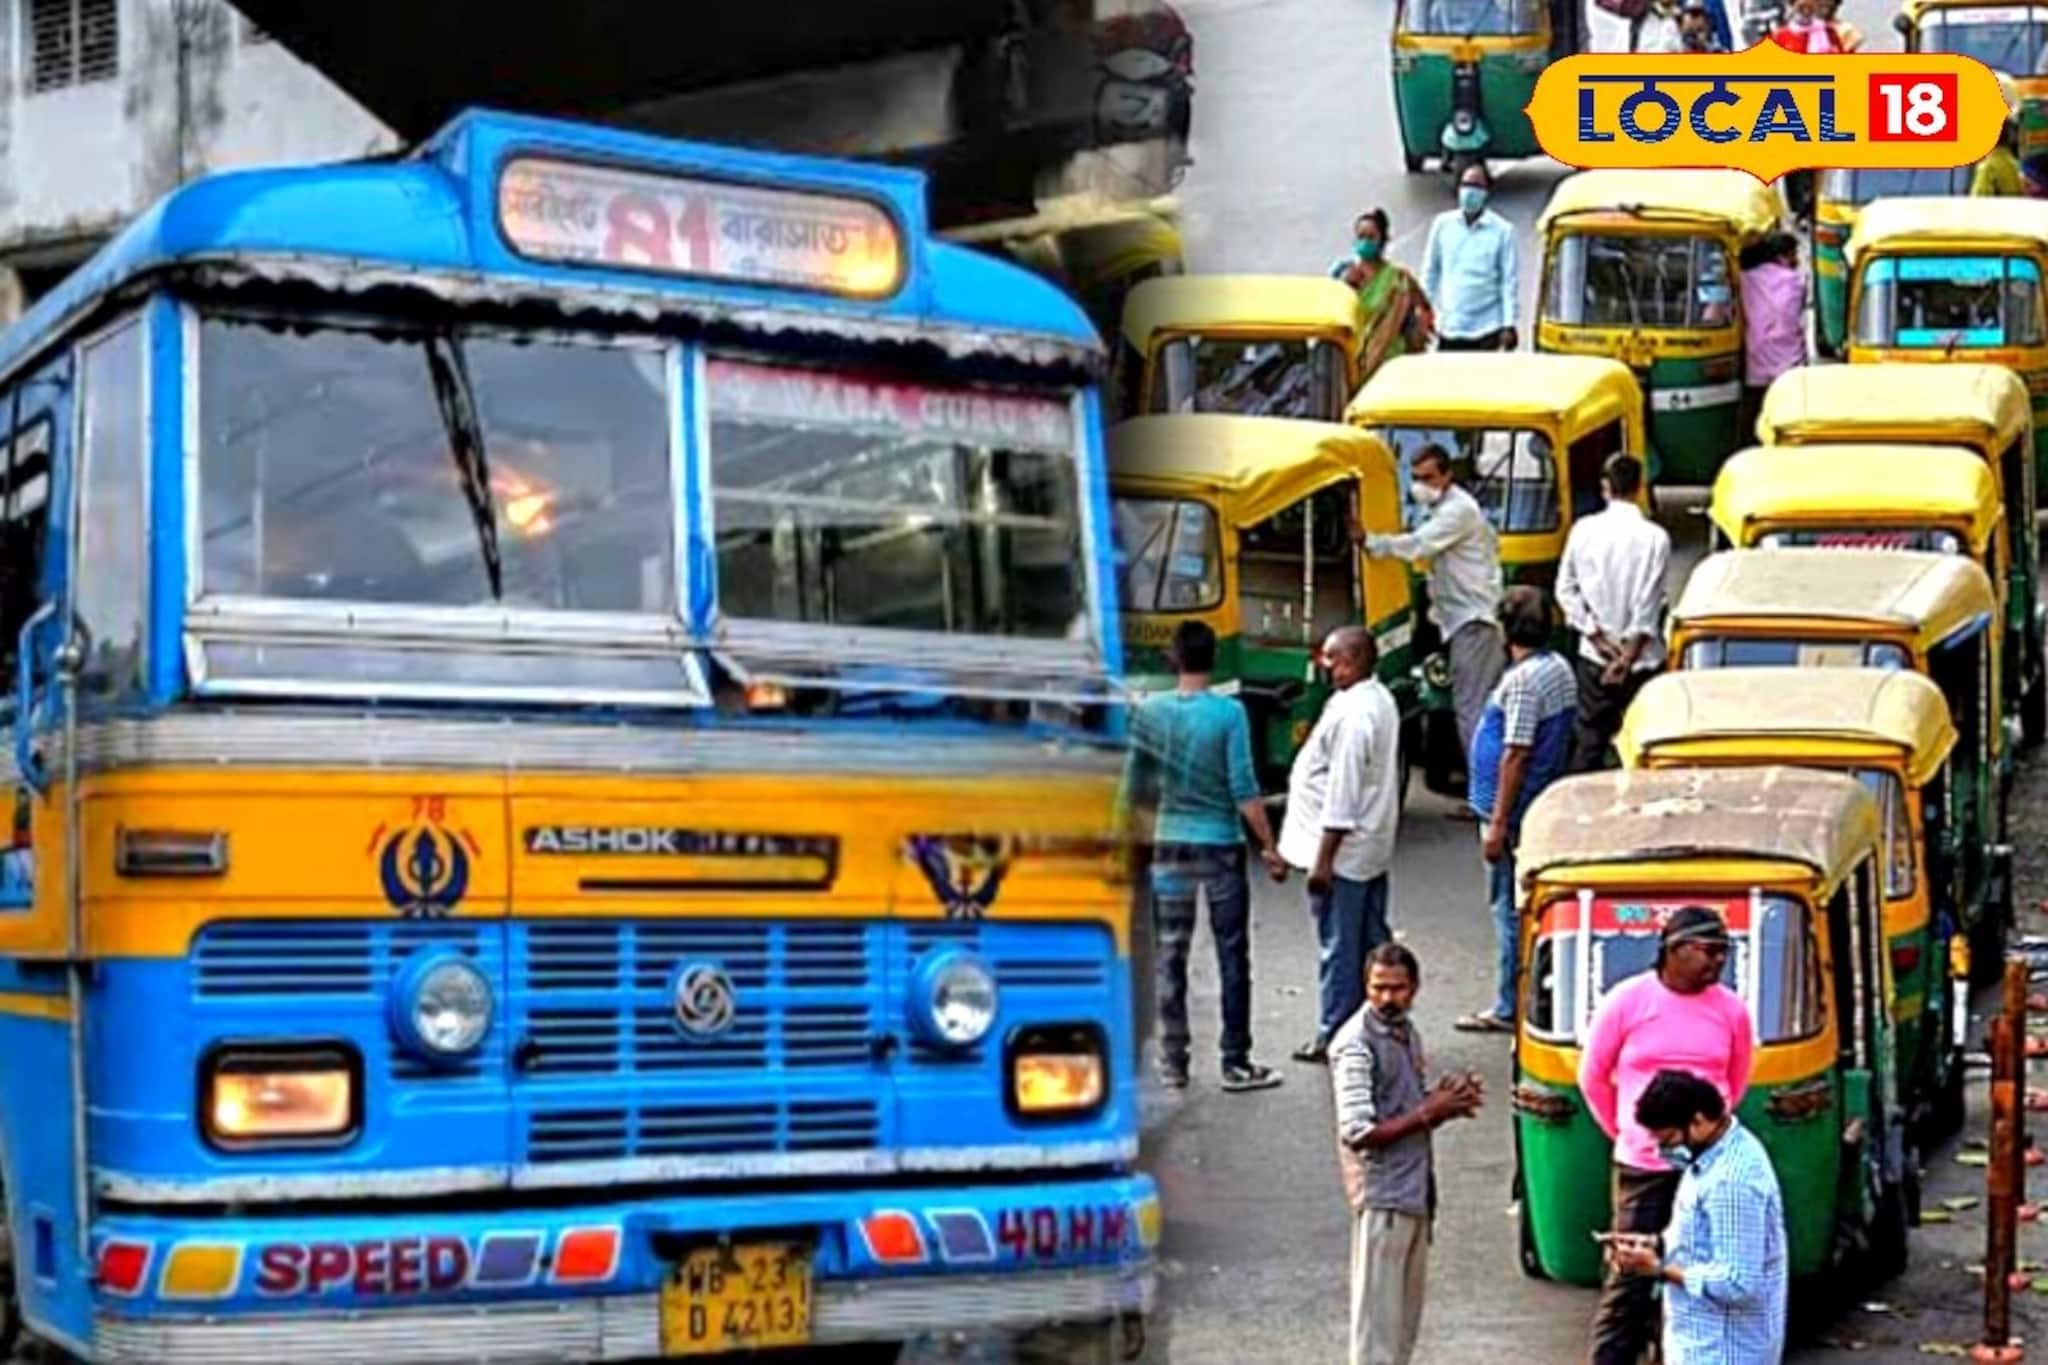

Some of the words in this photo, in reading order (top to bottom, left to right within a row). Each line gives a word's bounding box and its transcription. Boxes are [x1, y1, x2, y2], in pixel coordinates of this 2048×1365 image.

[530, 826, 679, 854] ASHOK
[256, 1235, 472, 1294] SPEED
[751, 1256, 787, 1291] 23
[721, 1297, 794, 1338] 4213
